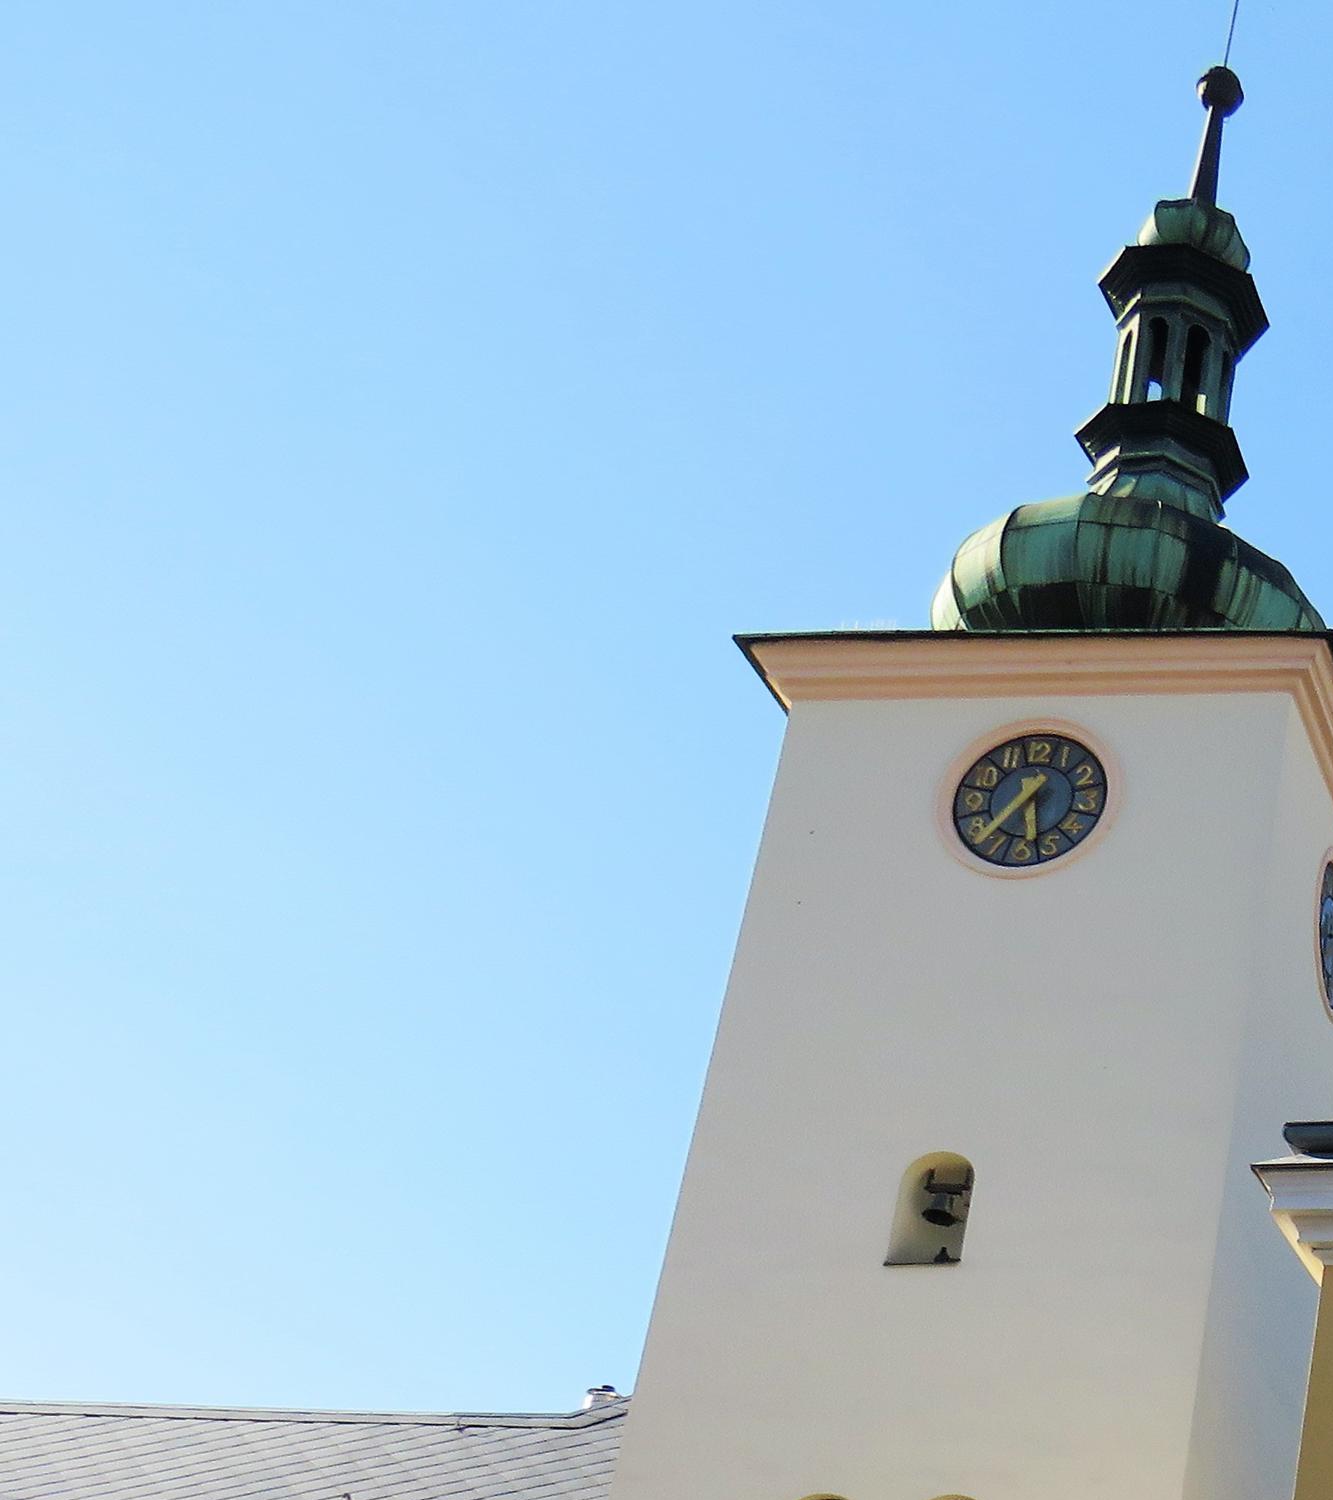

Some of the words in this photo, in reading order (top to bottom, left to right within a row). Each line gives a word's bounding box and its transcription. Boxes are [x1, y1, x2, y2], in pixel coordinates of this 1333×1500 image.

[1003, 746, 1021, 768] 11
[1027, 741, 1052, 763] 12
[1061, 746, 1071, 767] 1
[975, 766, 999, 787] 10
[1076, 765, 1094, 785] 2
[1076, 790, 1097, 811] 3
[970, 817, 986, 836] 8
[1061, 813, 1083, 834] 4
[1013, 839, 1031, 860] 6
[1040, 835, 1060, 856] 5
